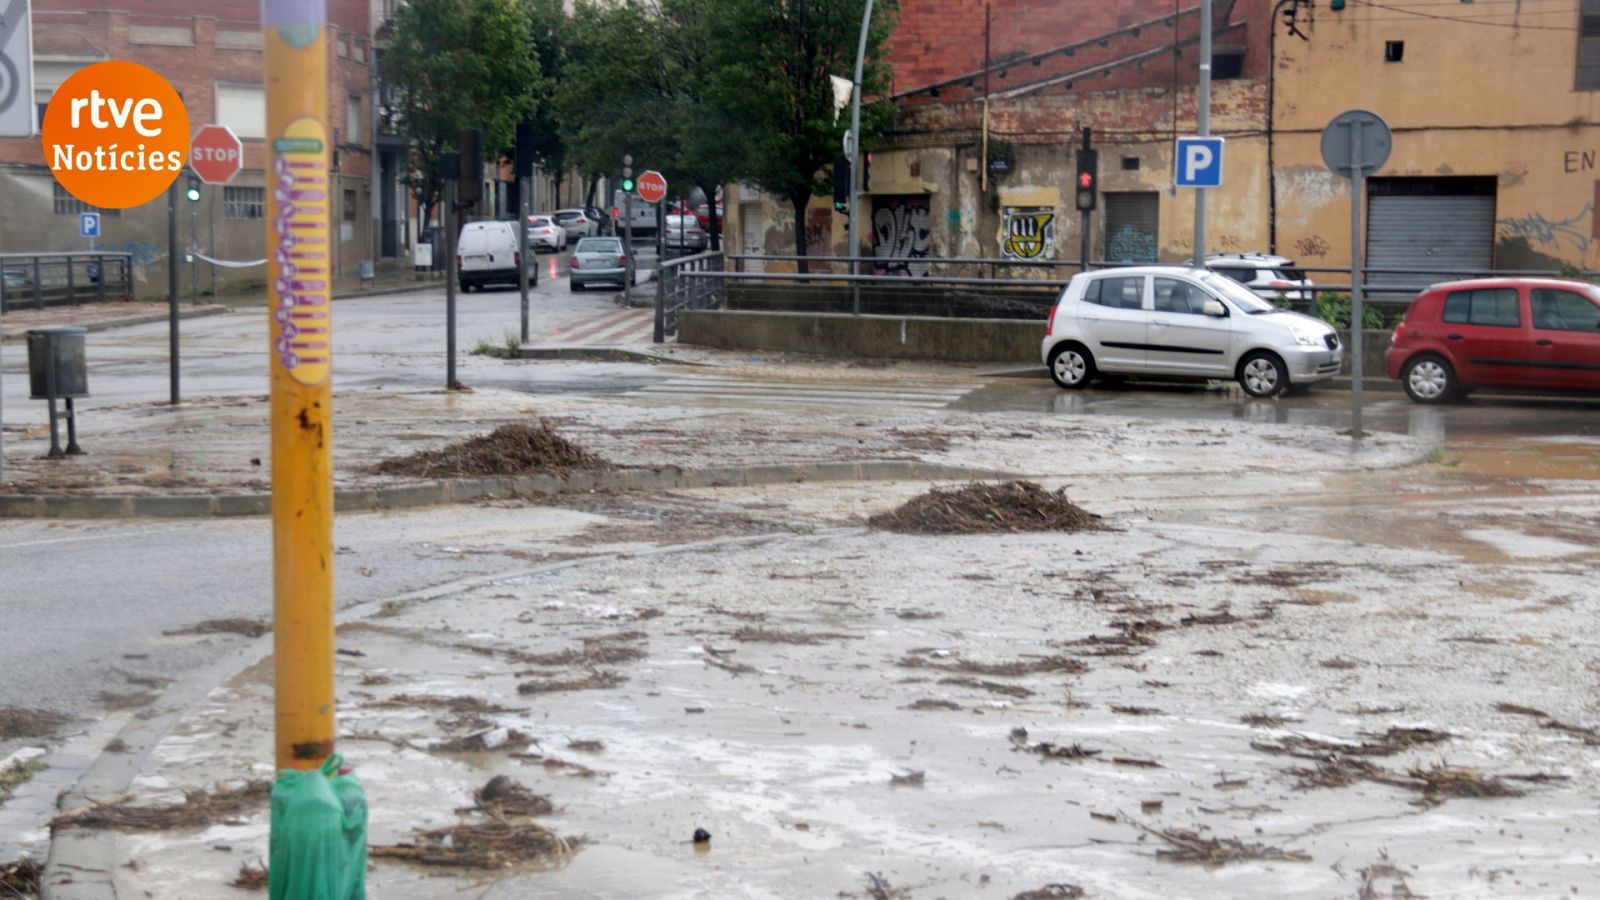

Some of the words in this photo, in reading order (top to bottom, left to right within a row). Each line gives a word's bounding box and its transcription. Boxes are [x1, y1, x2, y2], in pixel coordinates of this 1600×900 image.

[193, 147, 237, 162] STOP
[1185, 145, 1213, 181] P
[1564, 150, 1596, 173] EN
[639, 182, 664, 192] STOP
[84, 216, 96, 234] P
